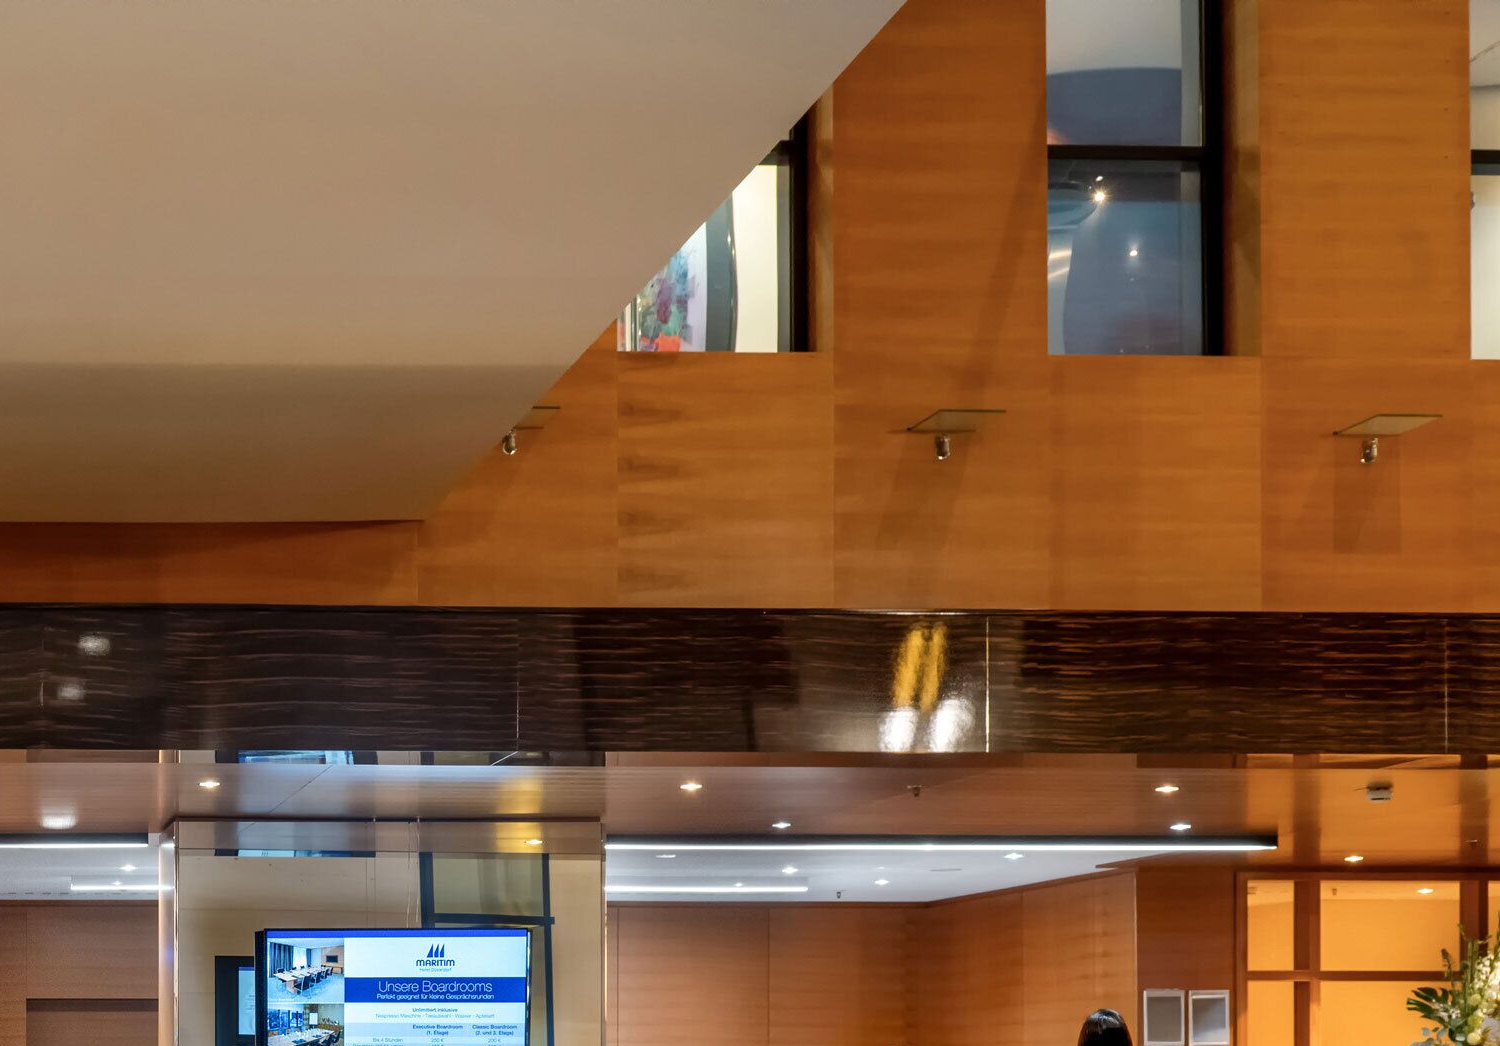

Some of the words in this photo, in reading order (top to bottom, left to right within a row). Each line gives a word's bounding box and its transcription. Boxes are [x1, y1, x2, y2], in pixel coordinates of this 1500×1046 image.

[415, 959, 455, 967] MARITIM
[378, 980, 419, 992] Unsere
[422, 980, 493, 992] Boardrooms
